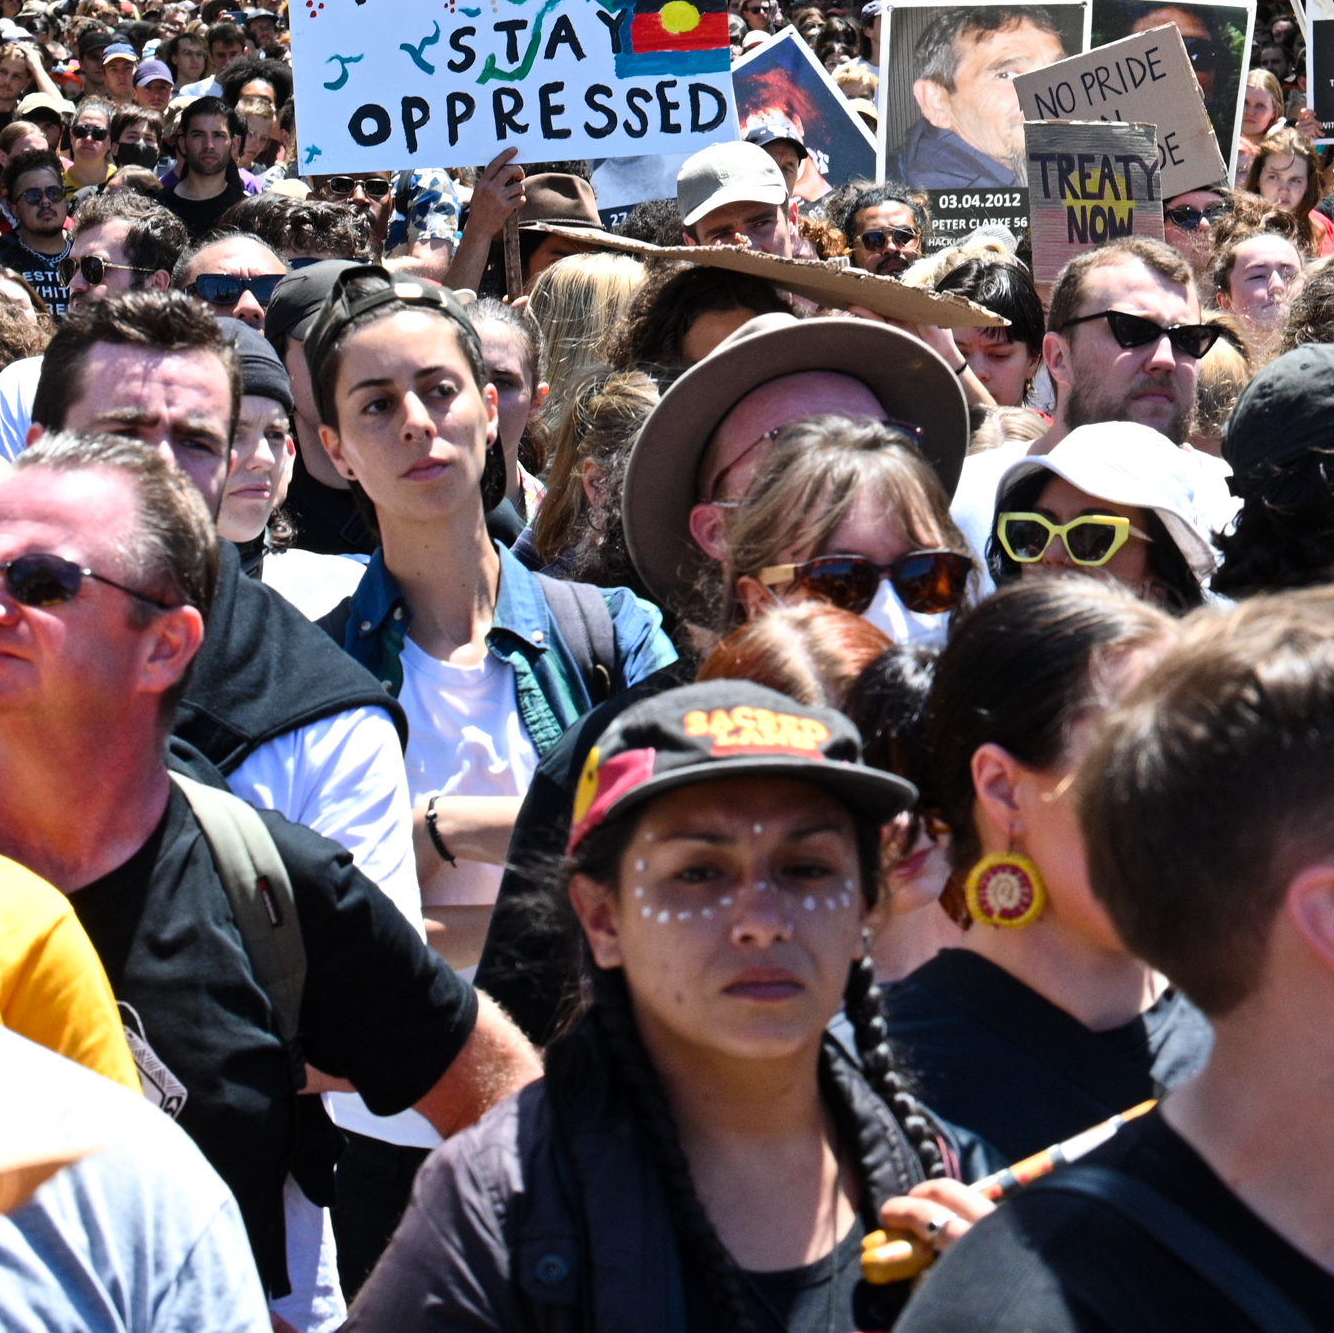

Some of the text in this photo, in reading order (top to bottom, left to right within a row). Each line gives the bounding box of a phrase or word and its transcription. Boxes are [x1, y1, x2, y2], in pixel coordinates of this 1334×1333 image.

[447, 8, 628, 73] STAY
[1034, 46, 1166, 120] NO PRIDE
[348, 79, 727, 154] OPPRESSED
[1029, 153, 1159, 202] TREATY
[609, 211, 627, 227] 27
[938, 193, 1021, 209] 03.04.2012
[928, 237, 957, 247] HACKI
[931, 217, 1028, 230] PETER CLARKE 56
[1067, 204, 1134, 244] NOW
[683, 706, 830, 743] SACRED
[713, 727, 819, 751] LAND
